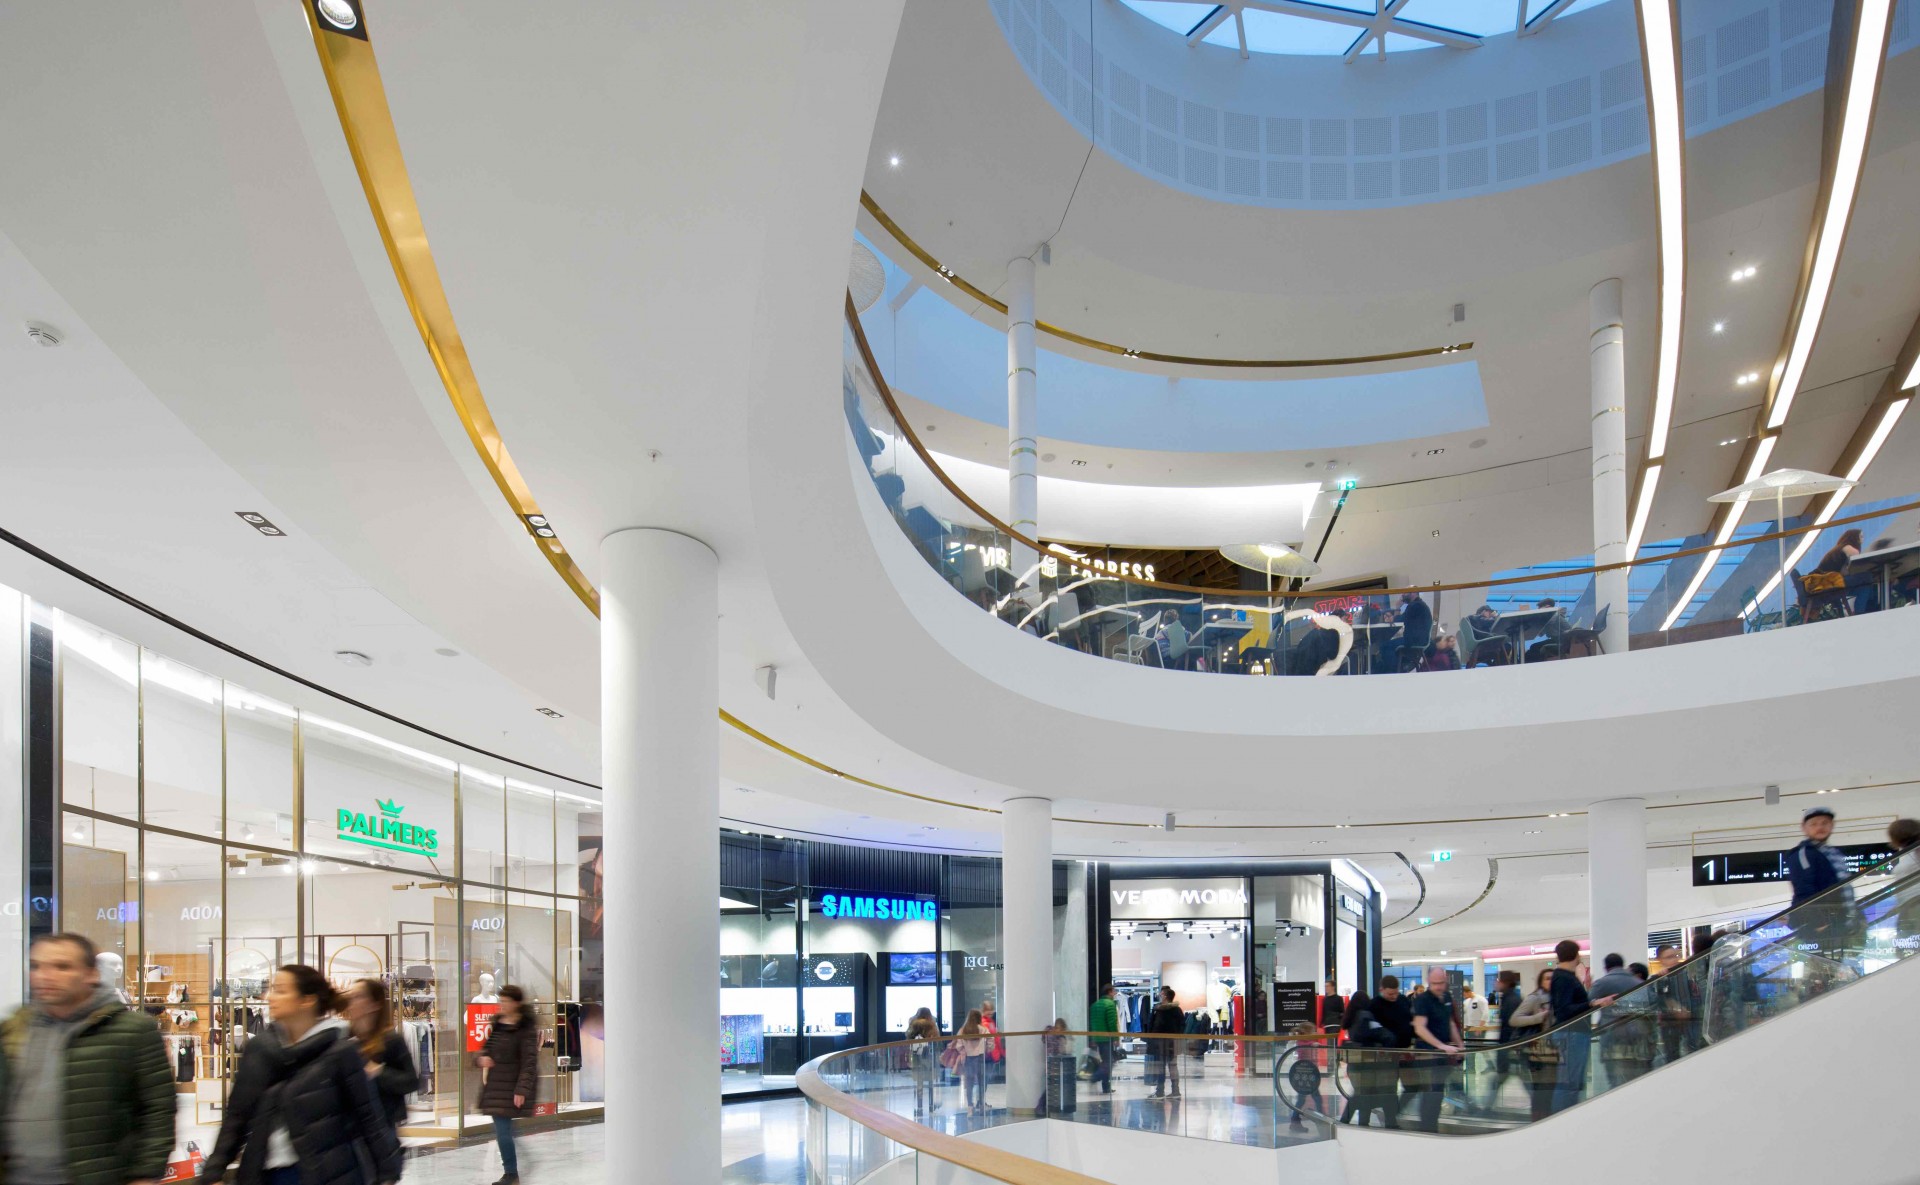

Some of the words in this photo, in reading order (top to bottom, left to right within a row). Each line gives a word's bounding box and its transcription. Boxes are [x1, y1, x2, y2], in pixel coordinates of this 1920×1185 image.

[1313, 595, 1366, 614] STAR
[337, 808, 438, 850] PALMERS
[1702, 859, 1715, 881] 1
[1180, 888, 1248, 905] MODA
[822, 895, 936, 921] SAMSUNG
